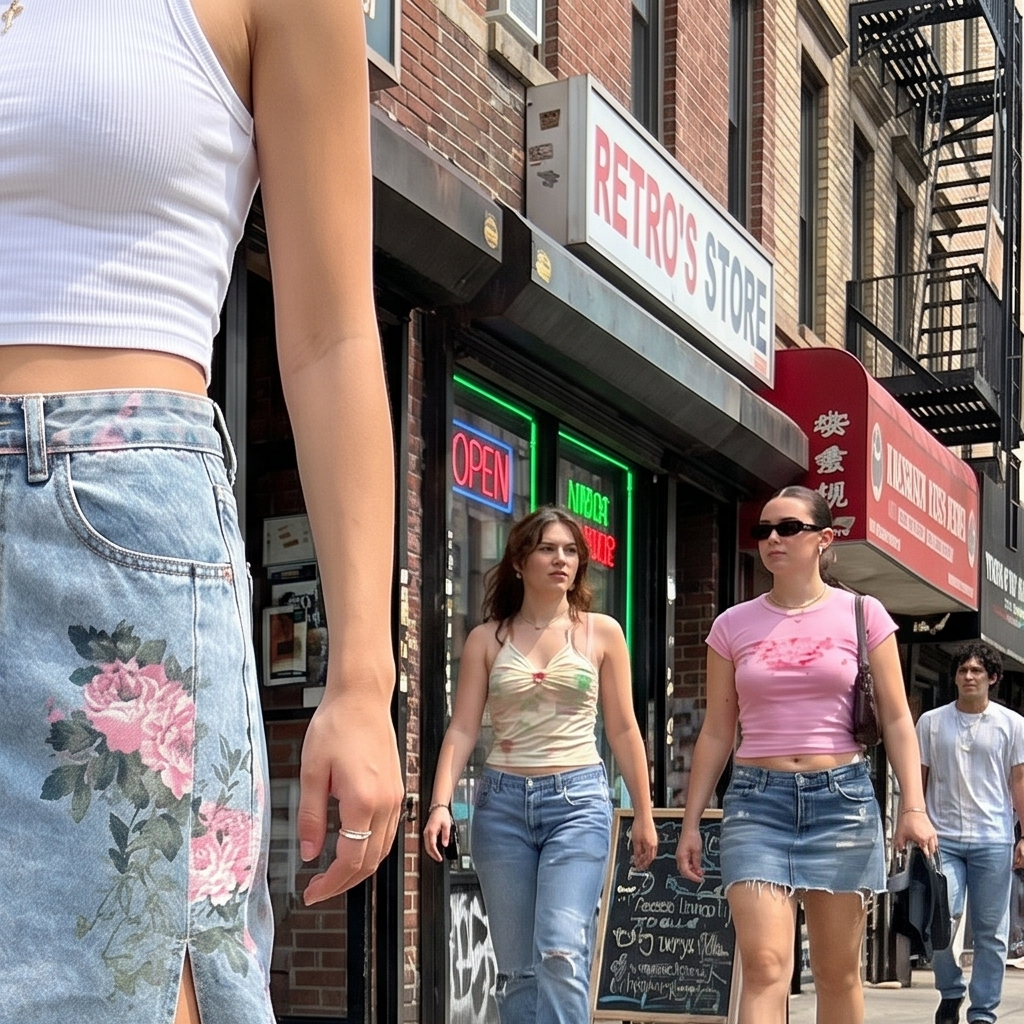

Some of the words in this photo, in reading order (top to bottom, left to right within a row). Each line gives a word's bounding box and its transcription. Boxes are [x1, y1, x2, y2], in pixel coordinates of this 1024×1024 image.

[593, 124, 698, 296] RETRO'S
[704, 231, 767, 356] STORE
[452, 432, 509, 504] OPEN
